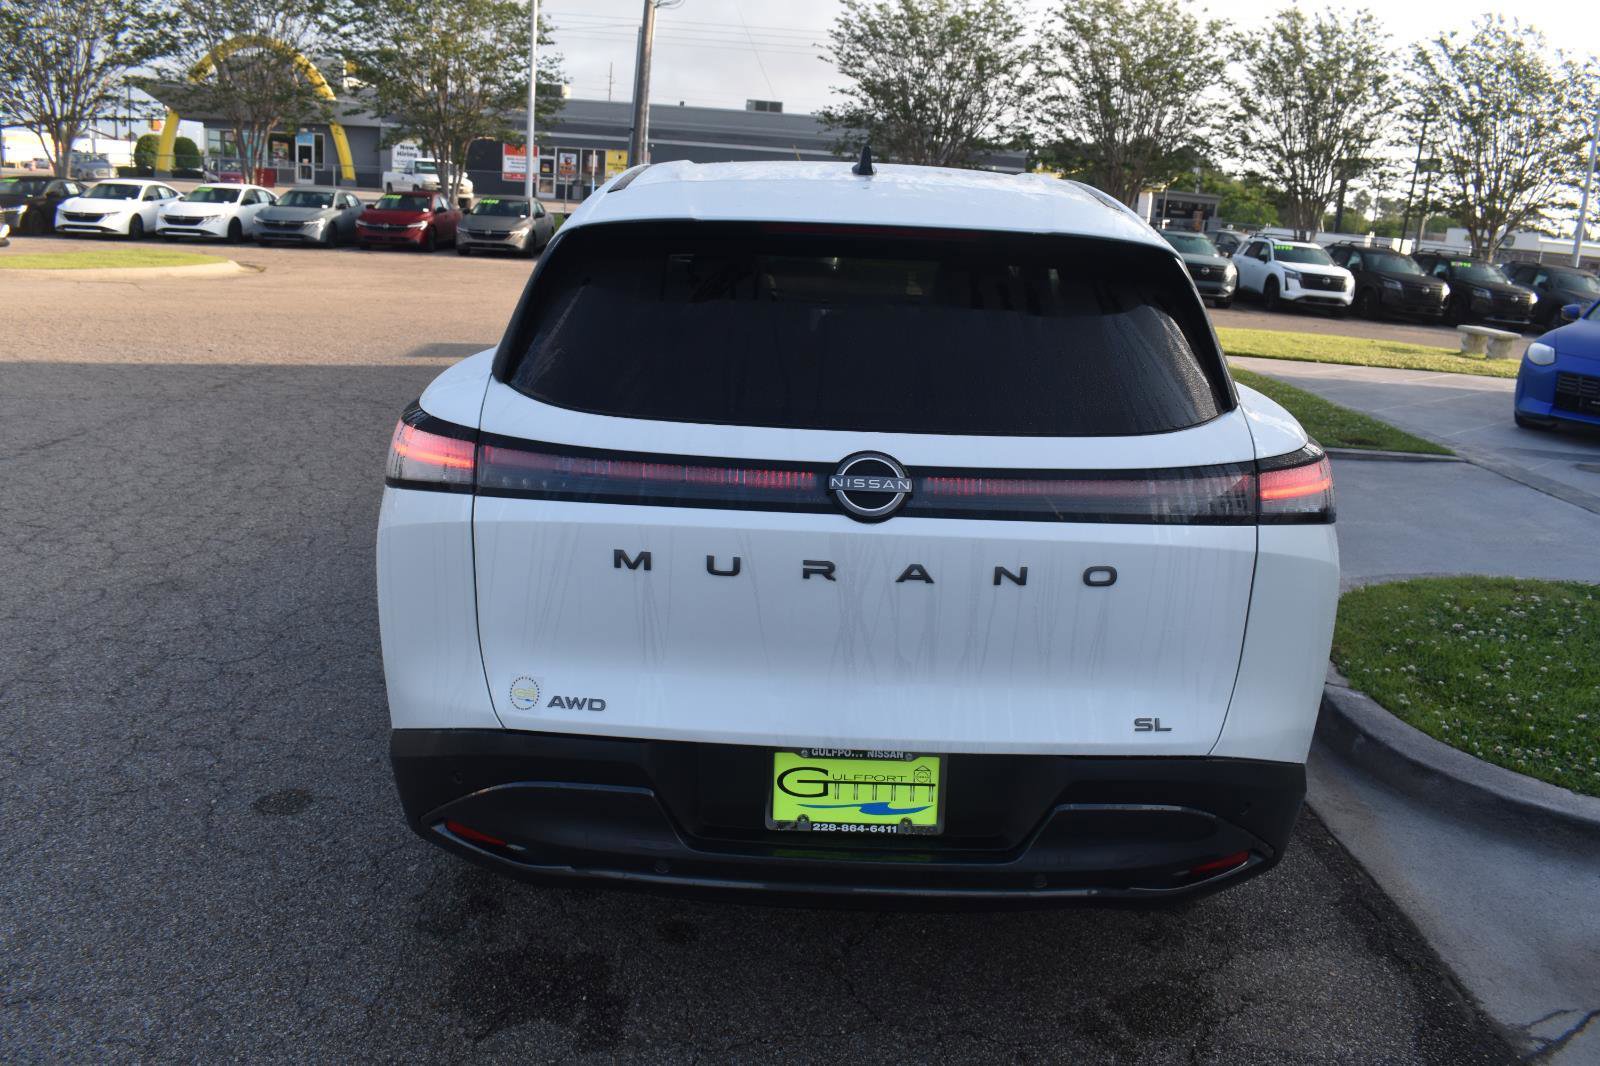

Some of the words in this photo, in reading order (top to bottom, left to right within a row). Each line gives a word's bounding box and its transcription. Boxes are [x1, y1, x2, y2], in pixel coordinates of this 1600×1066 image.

[831, 478, 910, 490] NISSAN
[613, 549, 1119, 587] MURANO
[547, 695, 607, 711] AWD
[1134, 717, 1172, 733] SL
[811, 747, 863, 758] GULFPO
[867, 750, 904, 759] NISSAN
[812, 823, 898, 834] 228-864-6411
